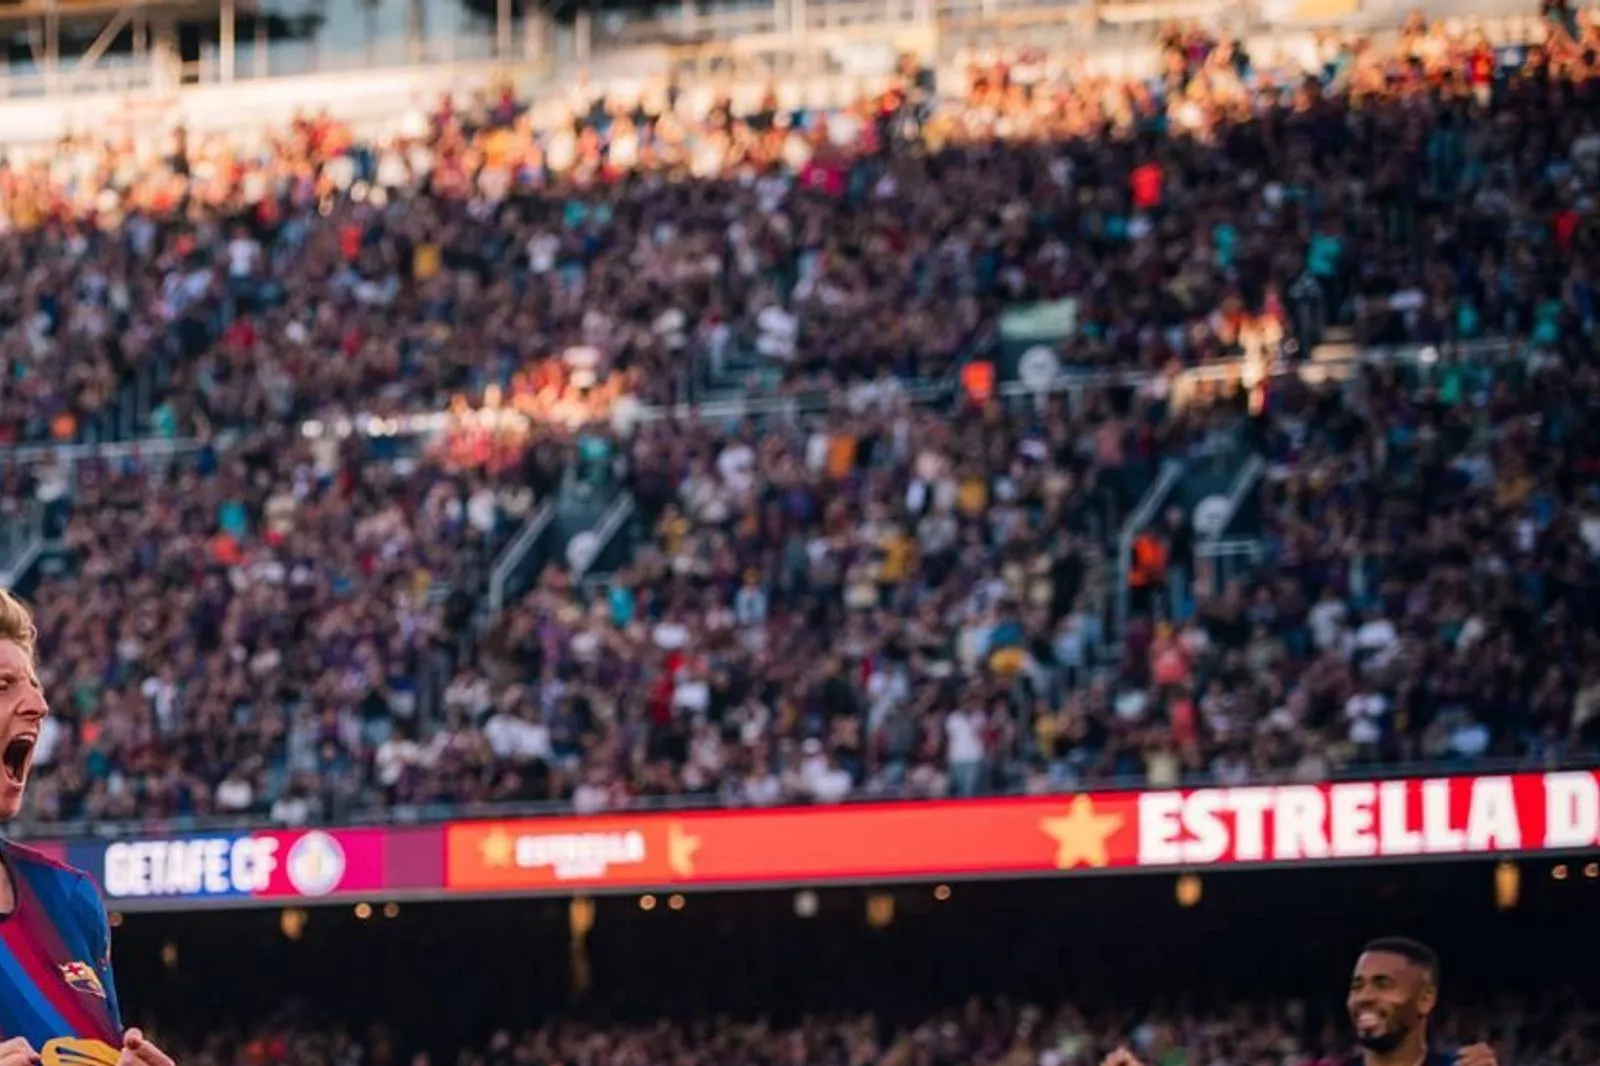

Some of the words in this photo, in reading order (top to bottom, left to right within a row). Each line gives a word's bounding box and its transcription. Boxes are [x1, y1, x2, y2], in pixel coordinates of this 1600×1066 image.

[1137, 777, 1521, 866] ESTRELLA
[1543, 770, 1600, 848] D
[104, 838, 231, 897] GETAFE
[230, 836, 279, 893] CF
